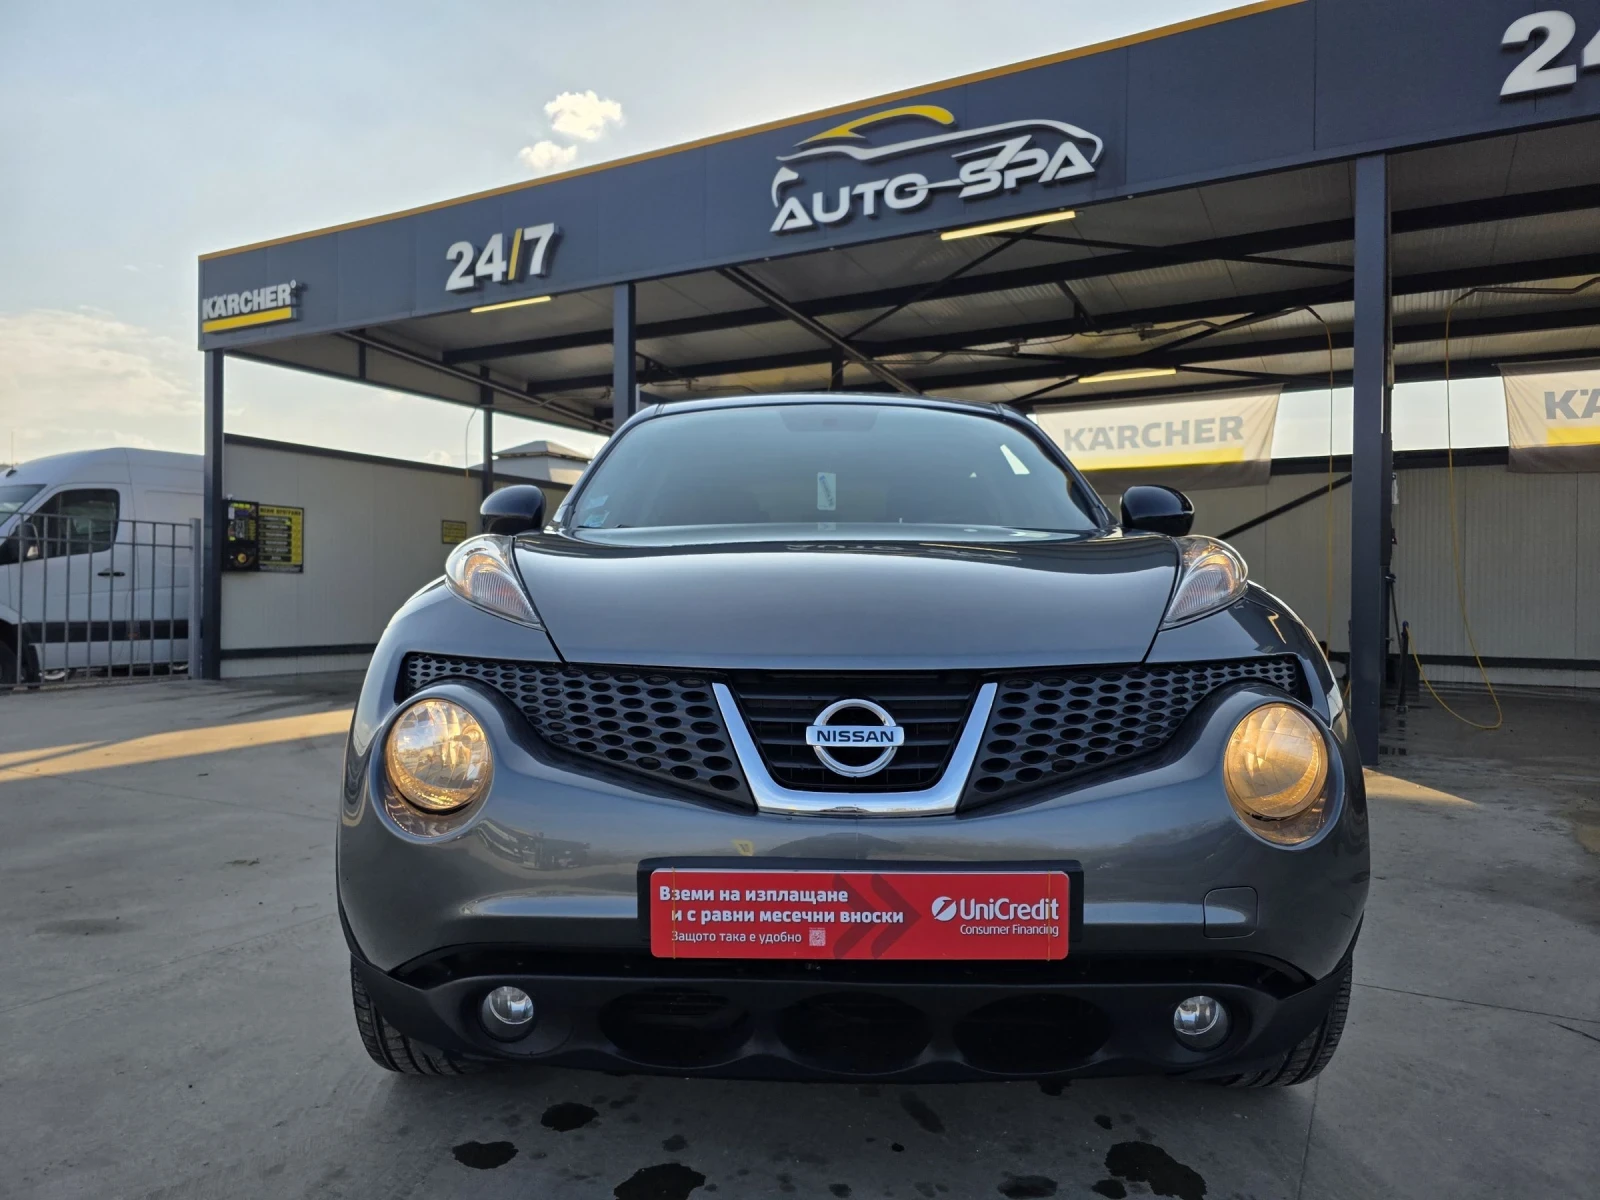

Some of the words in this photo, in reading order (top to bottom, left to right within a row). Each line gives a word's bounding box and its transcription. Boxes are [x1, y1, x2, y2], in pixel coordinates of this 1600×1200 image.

[769, 172, 929, 233] AUTO
[958, 139, 1096, 198] SPA
[445, 222, 556, 292] 24/7
[1063, 416, 1244, 452] KÄRCHER
[816, 730, 894, 743] NISSAN
[659, 886, 715, 902] Вземи
[719, 889, 741, 902] на
[745, 889, 849, 905] изплащане
[671, 910, 683, 922] и
[687, 910, 697, 922] с
[701, 910, 755, 925] равни
[759, 910, 835, 923] месечни
[840, 911, 904, 924] вноски
[960, 897, 1059, 921] UniCredit
[671, 930, 716, 944] Защото
[719, 931, 746, 942] така
[749, 932, 756, 942] е
[759, 931, 802, 945] удобно
[960, 924, 1010, 936] Consumer
[1012, 924, 1059, 938] Financing
